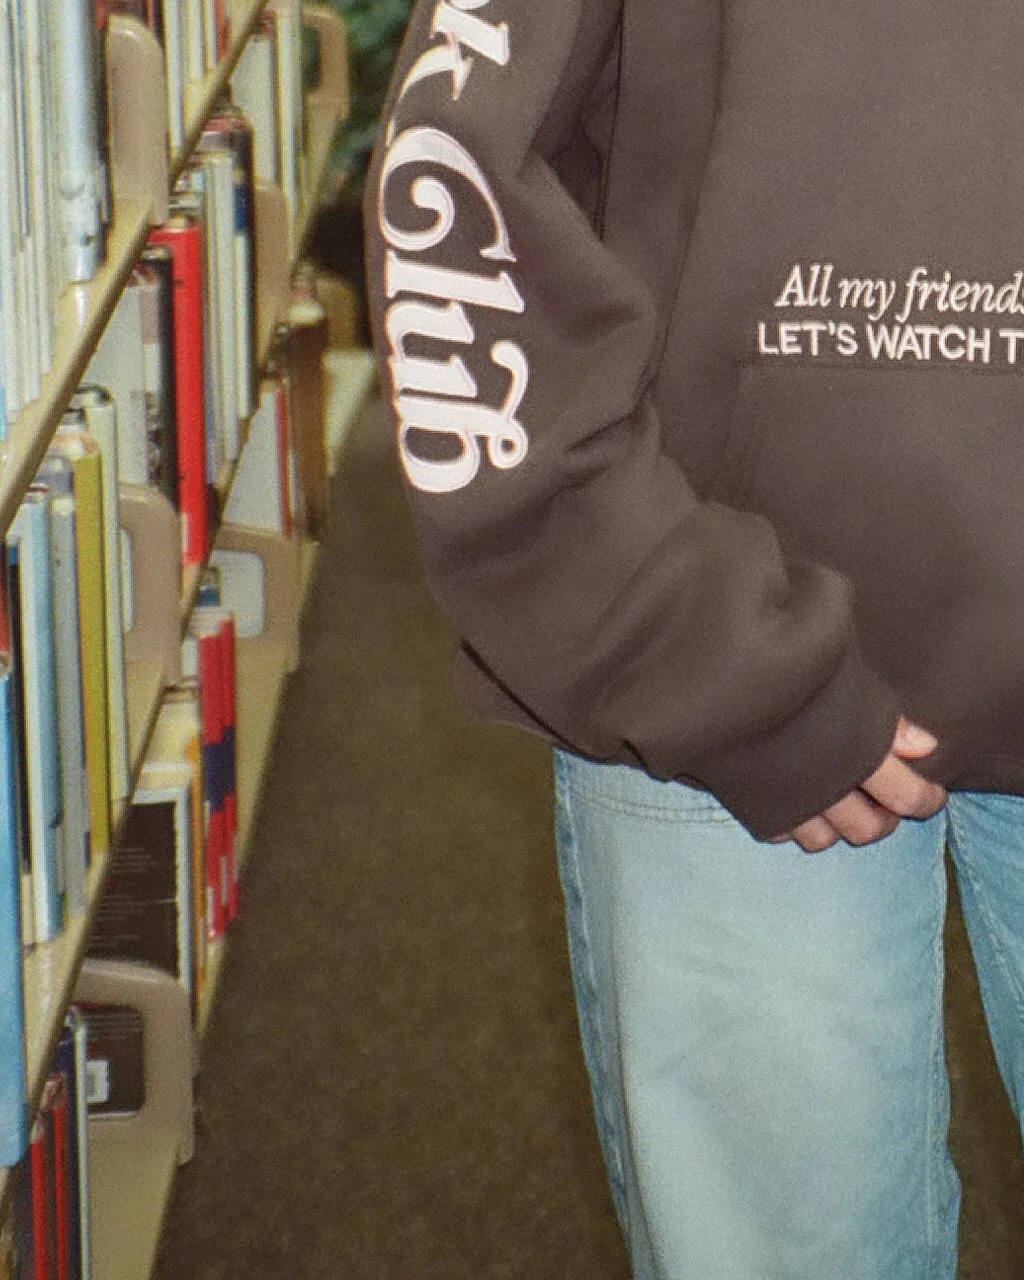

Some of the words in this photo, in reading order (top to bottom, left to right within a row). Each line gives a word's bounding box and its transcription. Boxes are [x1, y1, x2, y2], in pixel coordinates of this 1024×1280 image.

[378, 127, 528, 493] Club
[774, 263, 834, 307] All
[838, 278, 896, 321] my
[758, 321, 859, 357] LET'S
[865, 323, 991, 364] WATCH
